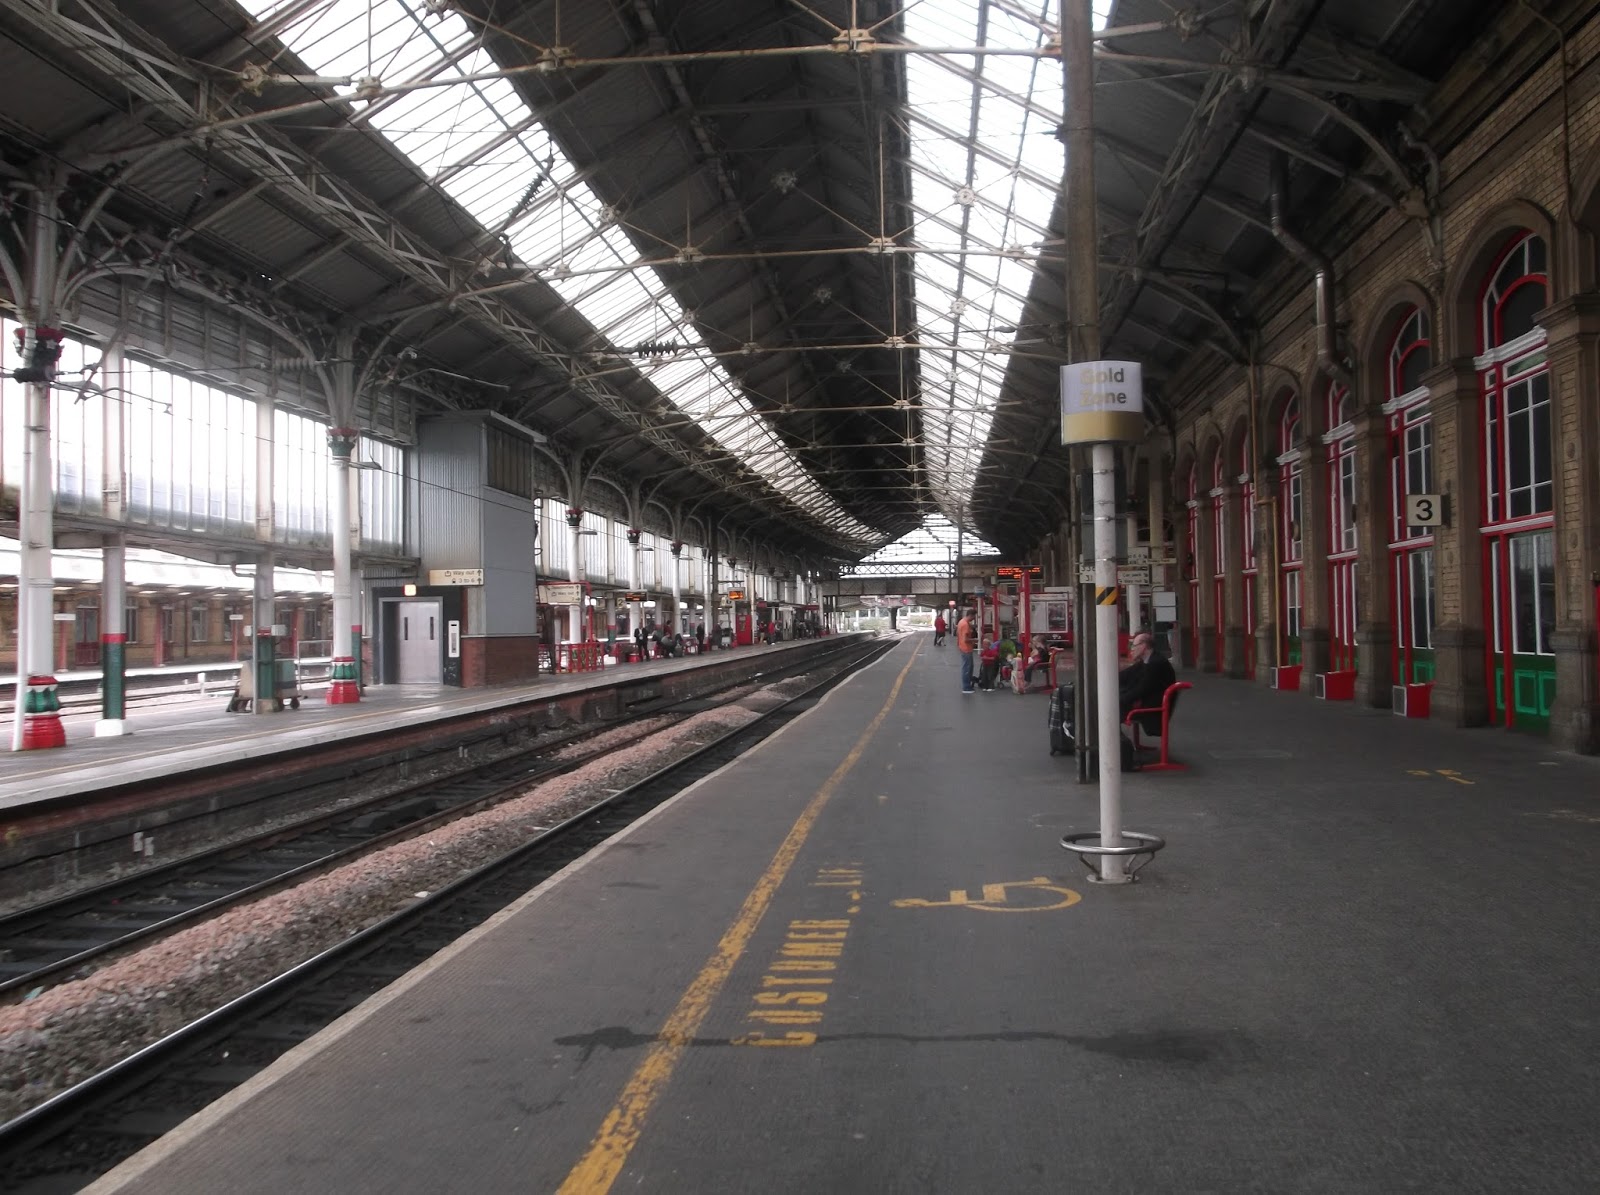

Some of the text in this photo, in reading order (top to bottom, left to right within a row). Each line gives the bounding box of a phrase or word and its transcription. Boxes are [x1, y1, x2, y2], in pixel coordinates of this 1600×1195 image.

[1080, 367, 1125, 385] Gold
[1080, 389, 1127, 407] Zone
[1415, 498, 1433, 521] 3
